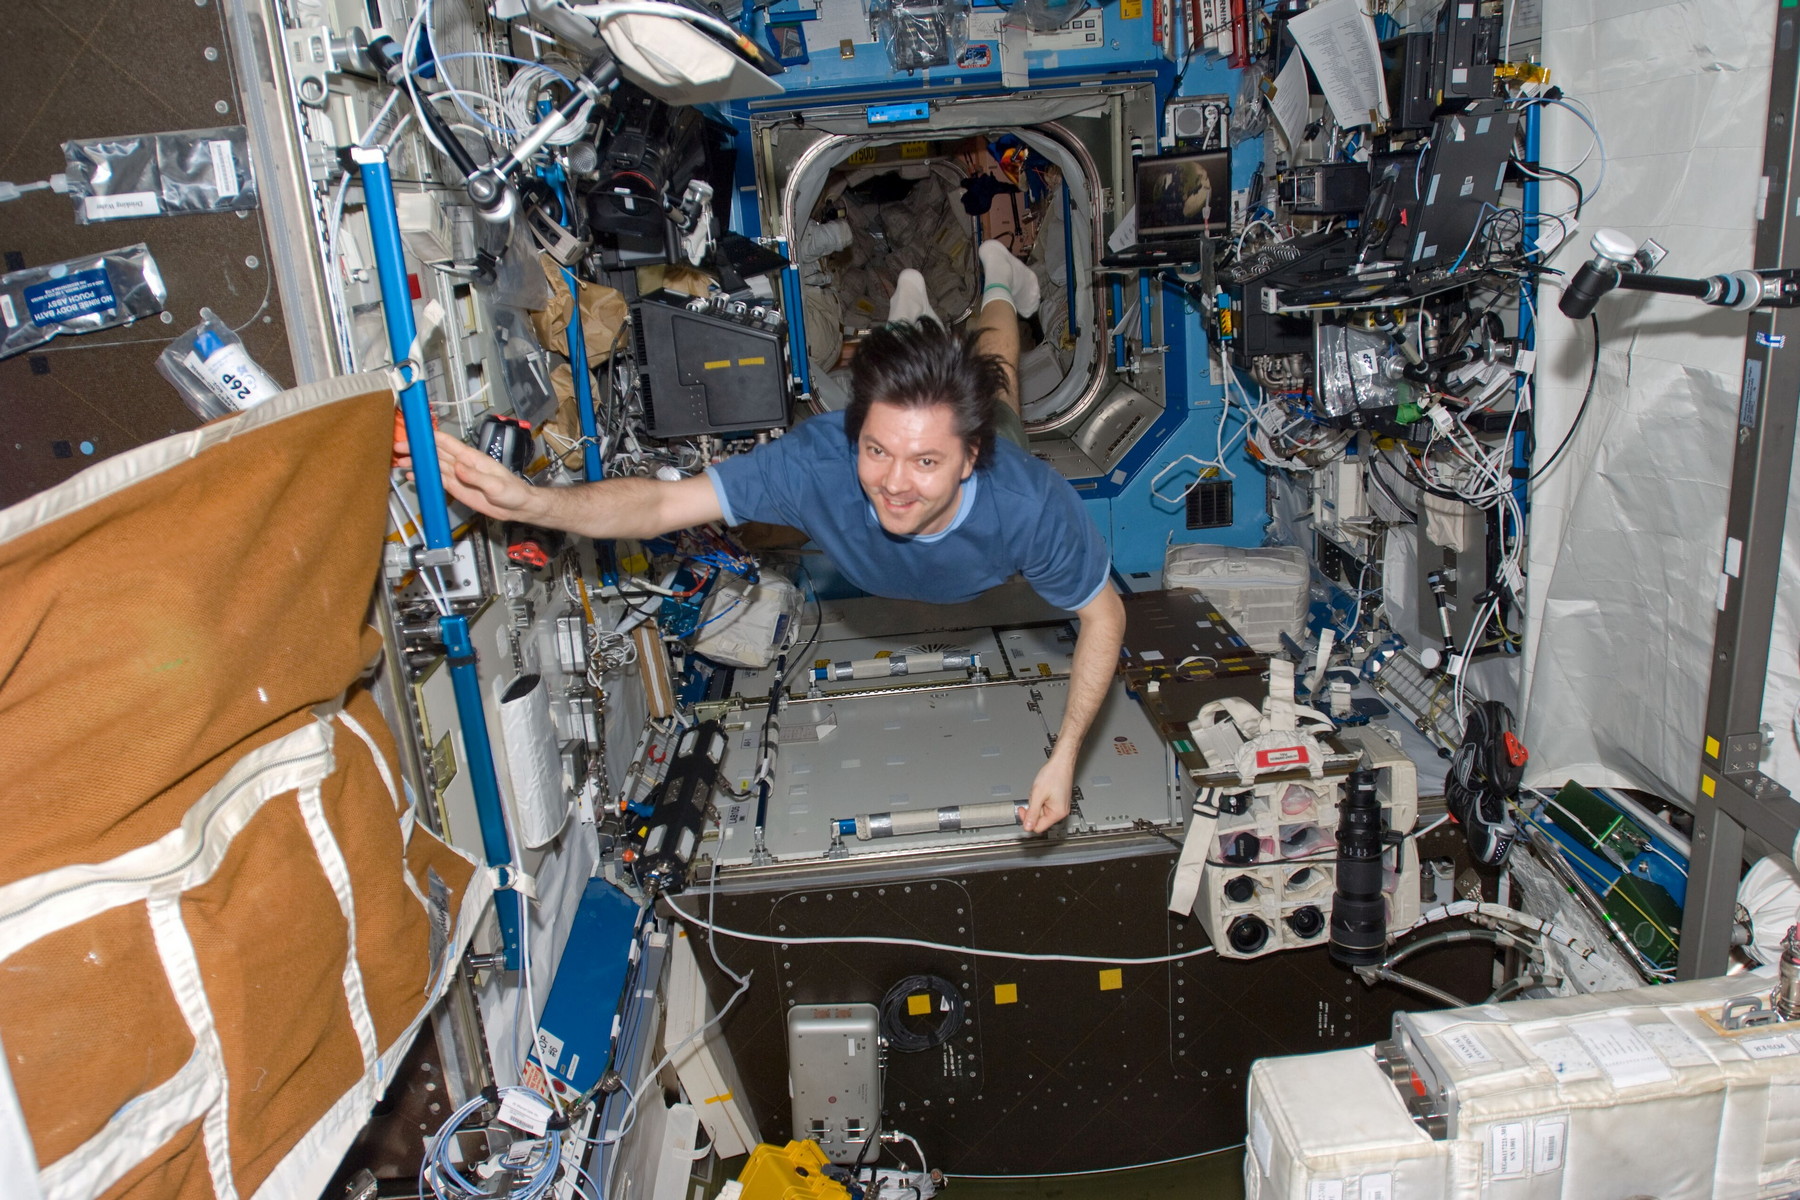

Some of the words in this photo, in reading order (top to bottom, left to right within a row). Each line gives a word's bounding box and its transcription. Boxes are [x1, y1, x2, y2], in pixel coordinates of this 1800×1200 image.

[116, 200, 144, 210] Drinking
[70, 291, 95, 301] POUCH
[48, 296, 70, 308] ASSY
[78, 297, 100, 309] RINSE
[34, 309, 55, 320] BATH
[57, 304, 77, 314] BODY
[222, 373, 251, 400] 26P
[549, 1046, 558, 1057] #6
[1754, 1043, 1786, 1052] POWER
